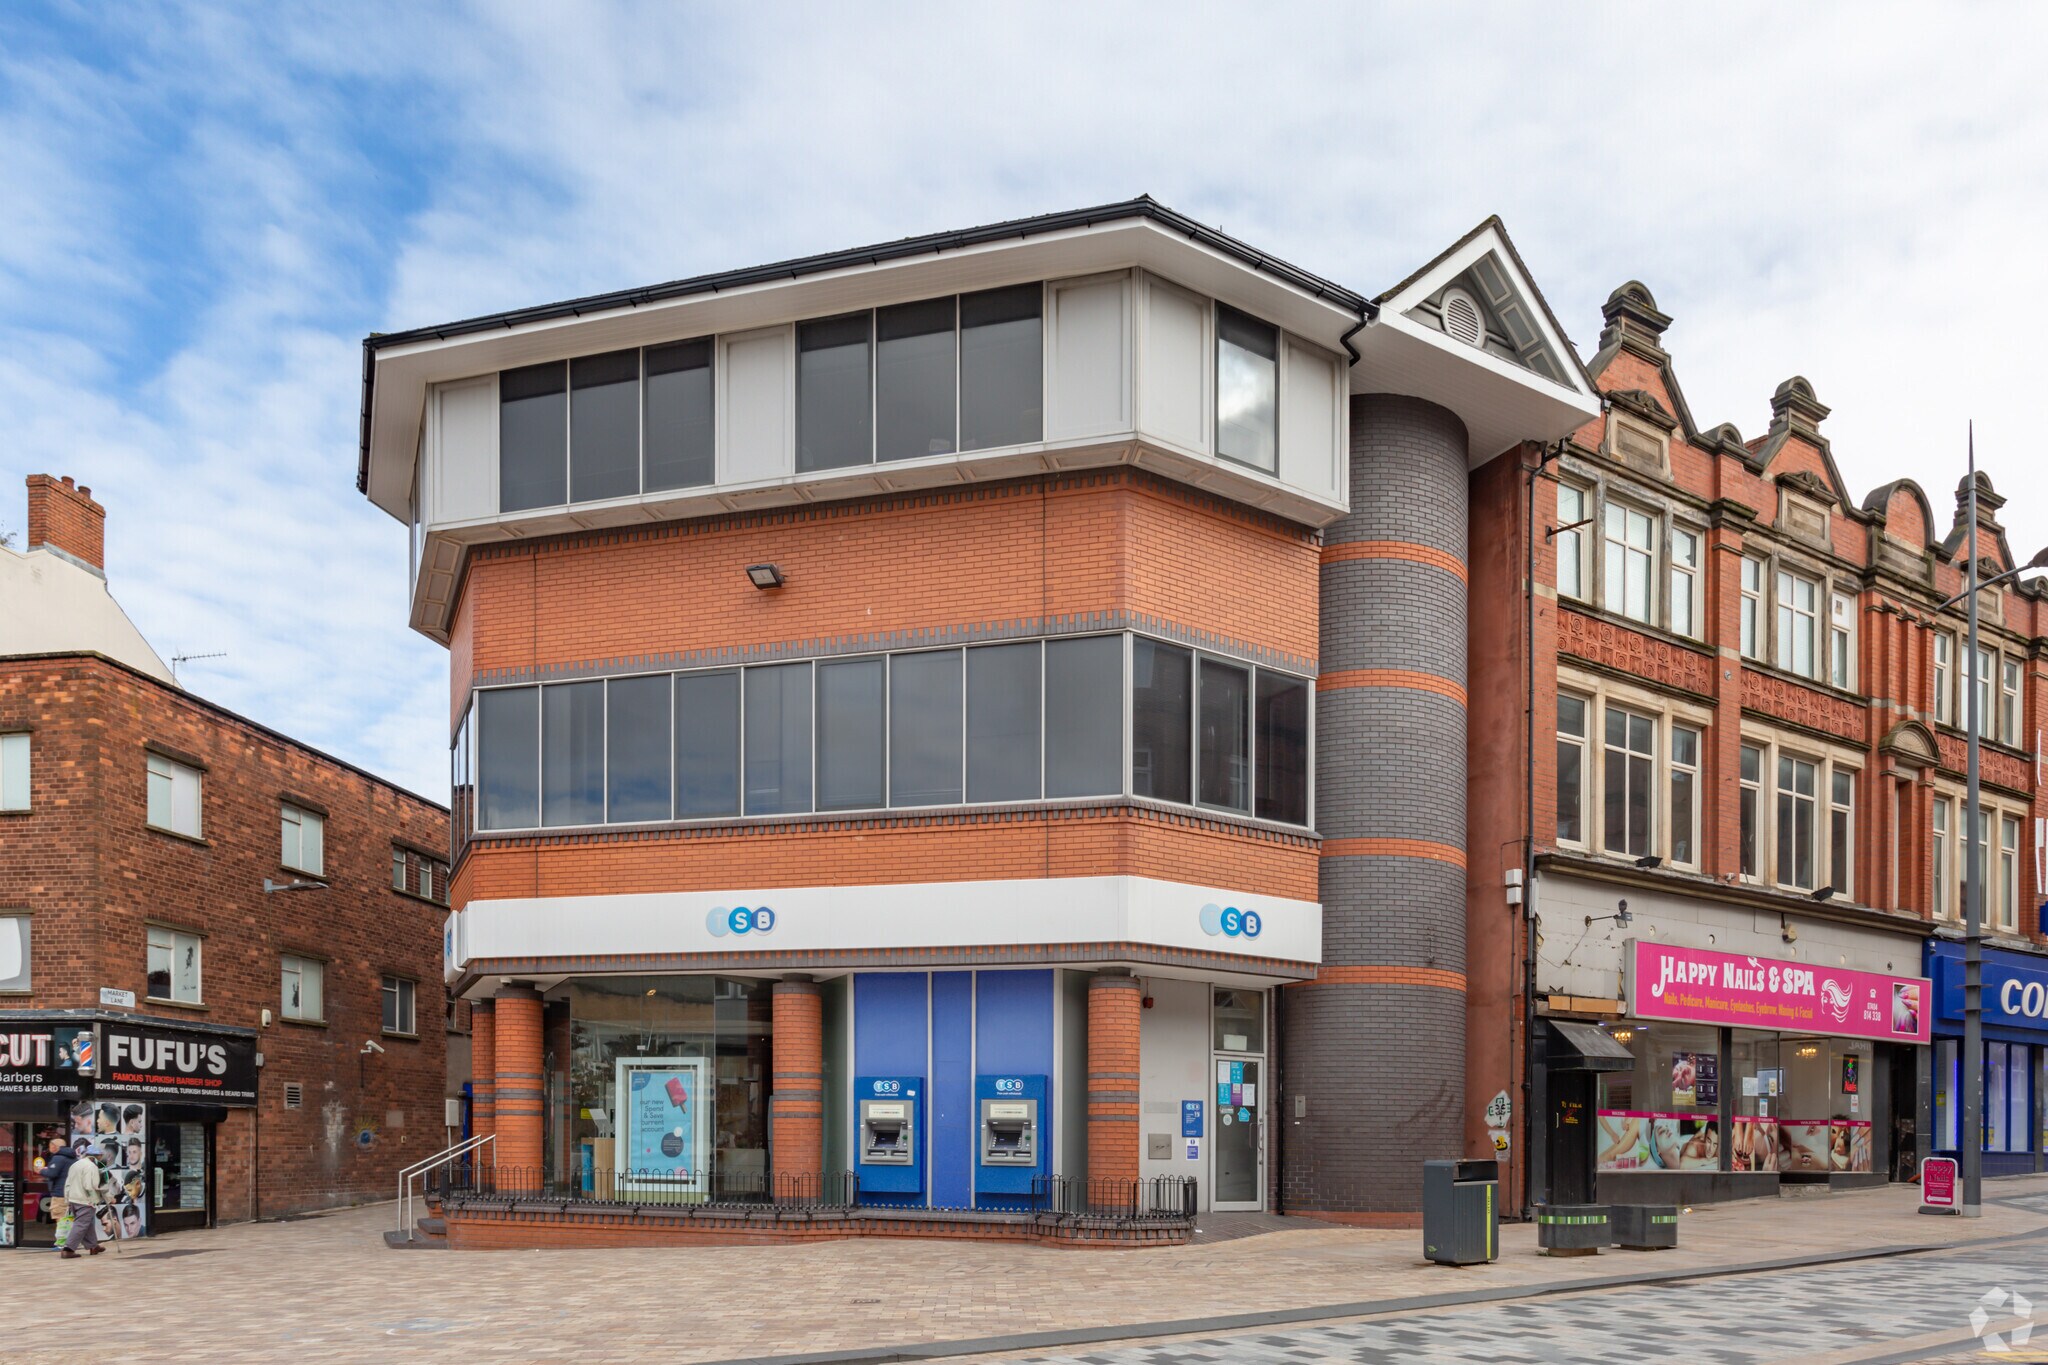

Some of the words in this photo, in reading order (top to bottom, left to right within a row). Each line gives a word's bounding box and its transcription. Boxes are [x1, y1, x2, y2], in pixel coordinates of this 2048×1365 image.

[1651, 955, 1718, 997] HAPPY
[1723, 961, 1765, 992] NAILS
[1768, 966, 1780, 993] &
[1782, 967, 1815, 996] SPA
[107, 990, 128, 998] MARKET
[2001, 978, 2048, 1019] CO
[110, 997, 124, 1005] LANE
[109, 1034, 227, 1075] FUFU'S
[112, 1072, 144, 1083] FAMOUS
[145, 1074, 175, 1084] TURKISH
[176, 1076, 204, 1086] BARBER
[204, 1078, 223, 1087] SHOP
[24, 1085, 31, 1093] &
[32, 1085, 58, 1093] BEARD
[60, 1085, 79, 1093] TRIM
[126, 1084, 142, 1093] CUTS,
[875, 1081, 899, 1091] TSB
[997, 1080, 1023, 1090] TSB
